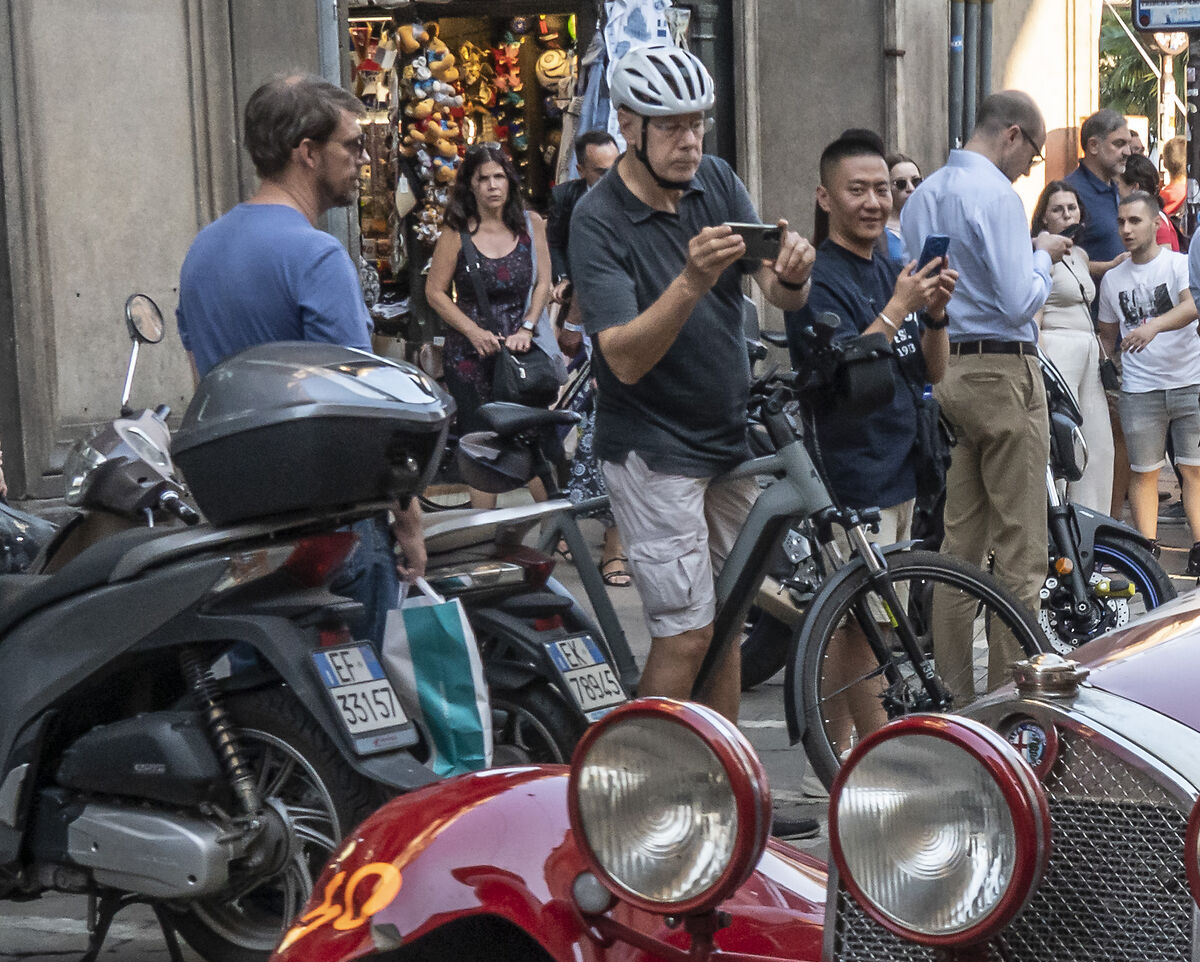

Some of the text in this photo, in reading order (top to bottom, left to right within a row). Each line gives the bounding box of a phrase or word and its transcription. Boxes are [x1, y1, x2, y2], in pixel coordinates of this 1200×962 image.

[329, 651, 355, 682] EF
[560, 641, 587, 667] EK
[569, 670, 620, 703] 78945
[337, 687, 396, 725] 33157
